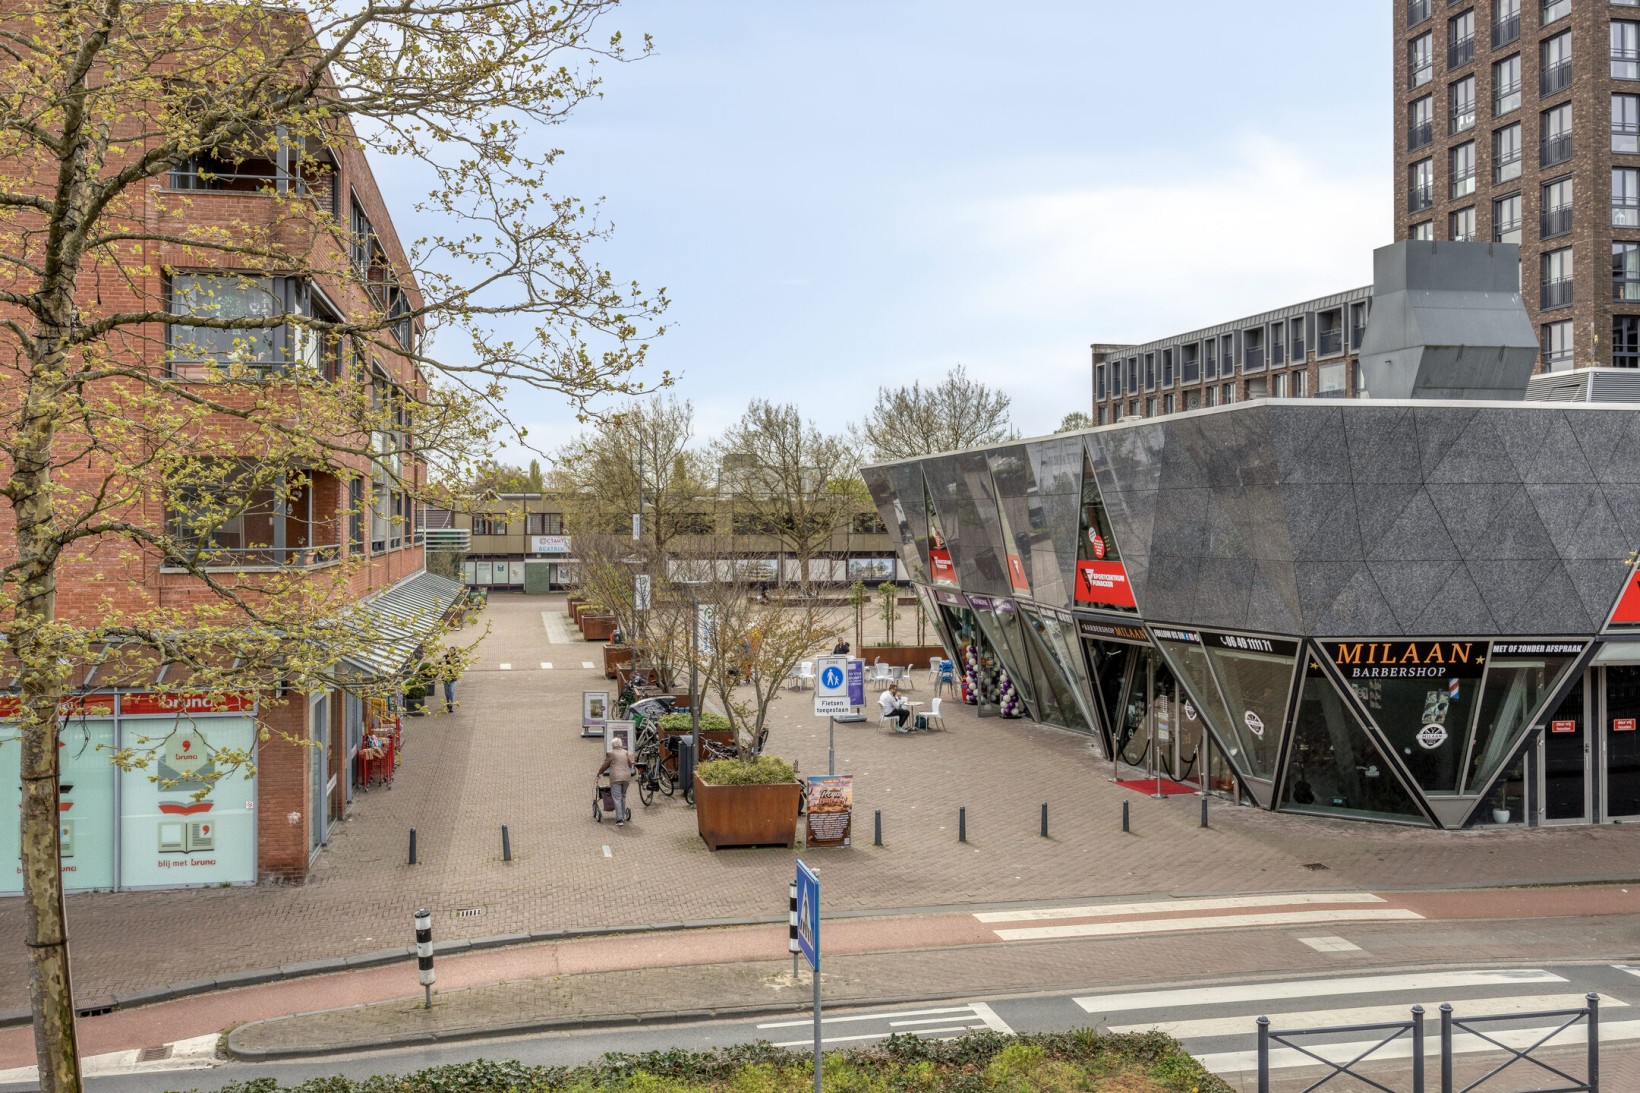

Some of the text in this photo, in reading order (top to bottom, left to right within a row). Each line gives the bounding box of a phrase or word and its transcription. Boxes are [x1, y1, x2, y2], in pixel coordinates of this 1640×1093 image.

[1093, 573, 1124, 582] SPORTCENTRUM
[1084, 624, 1147, 639] BARBERSHOP MILAAN
[1153, 629, 1171, 639] FOLLOW
[1226, 636, 1237, 648] 06
[1237, 637, 1248, 649] 49
[1335, 643, 1473, 664] MILAAN
[1492, 645, 1583, 653] MET OF ZONDER AFSPRAAK
[1352, 667, 1446, 677] BARBERSHOP
[158, 860, 171, 868] blij
[191, 858, 216, 866] bruna
